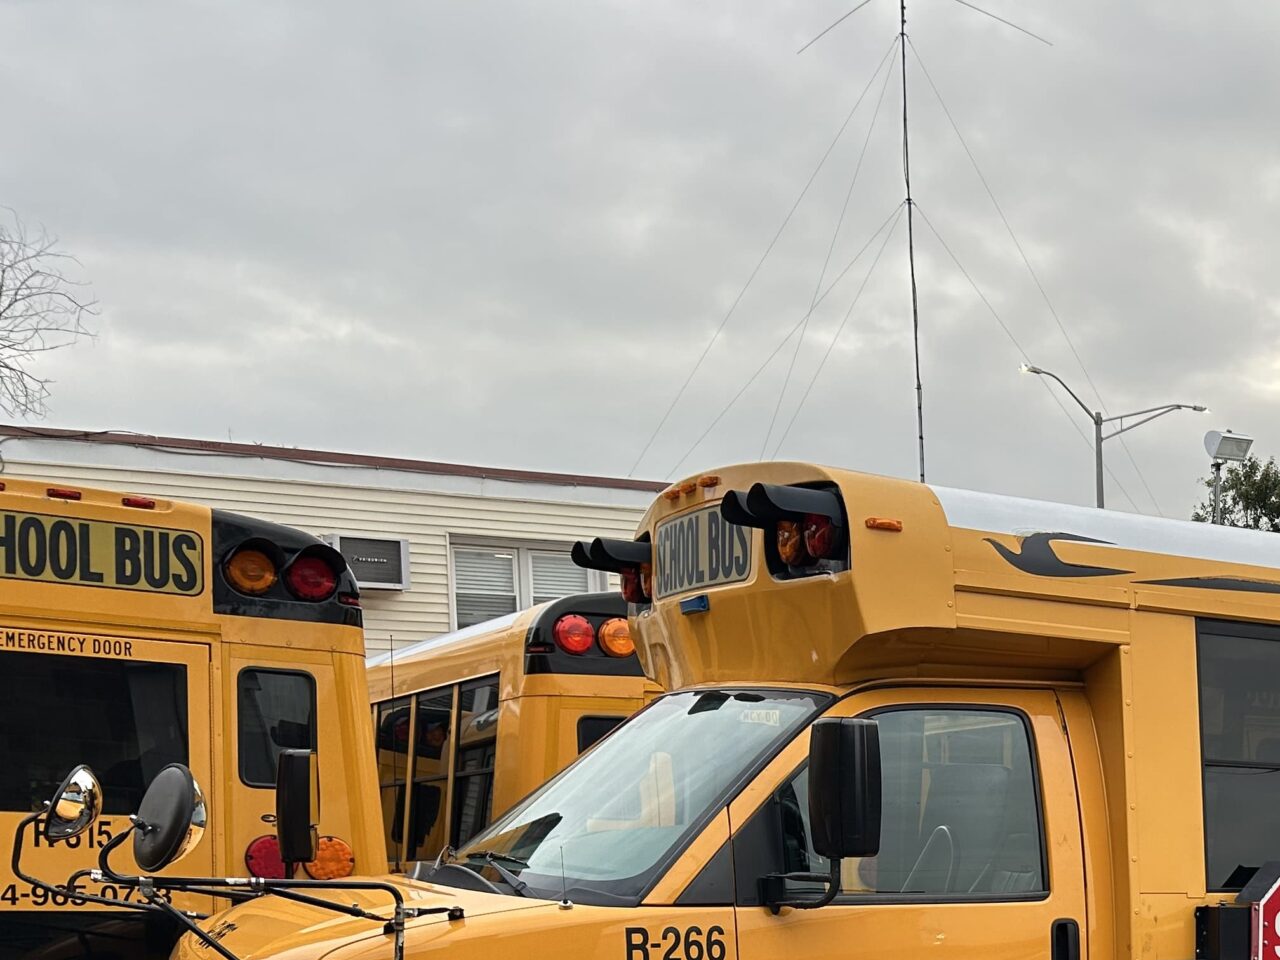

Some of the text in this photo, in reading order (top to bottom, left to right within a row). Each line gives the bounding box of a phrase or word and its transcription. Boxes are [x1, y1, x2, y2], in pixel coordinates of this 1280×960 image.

[114, 526, 198, 592] BUS
[657, 510, 748, 596] SCHOOL BUS
[93, 639, 133, 657] DOOR
